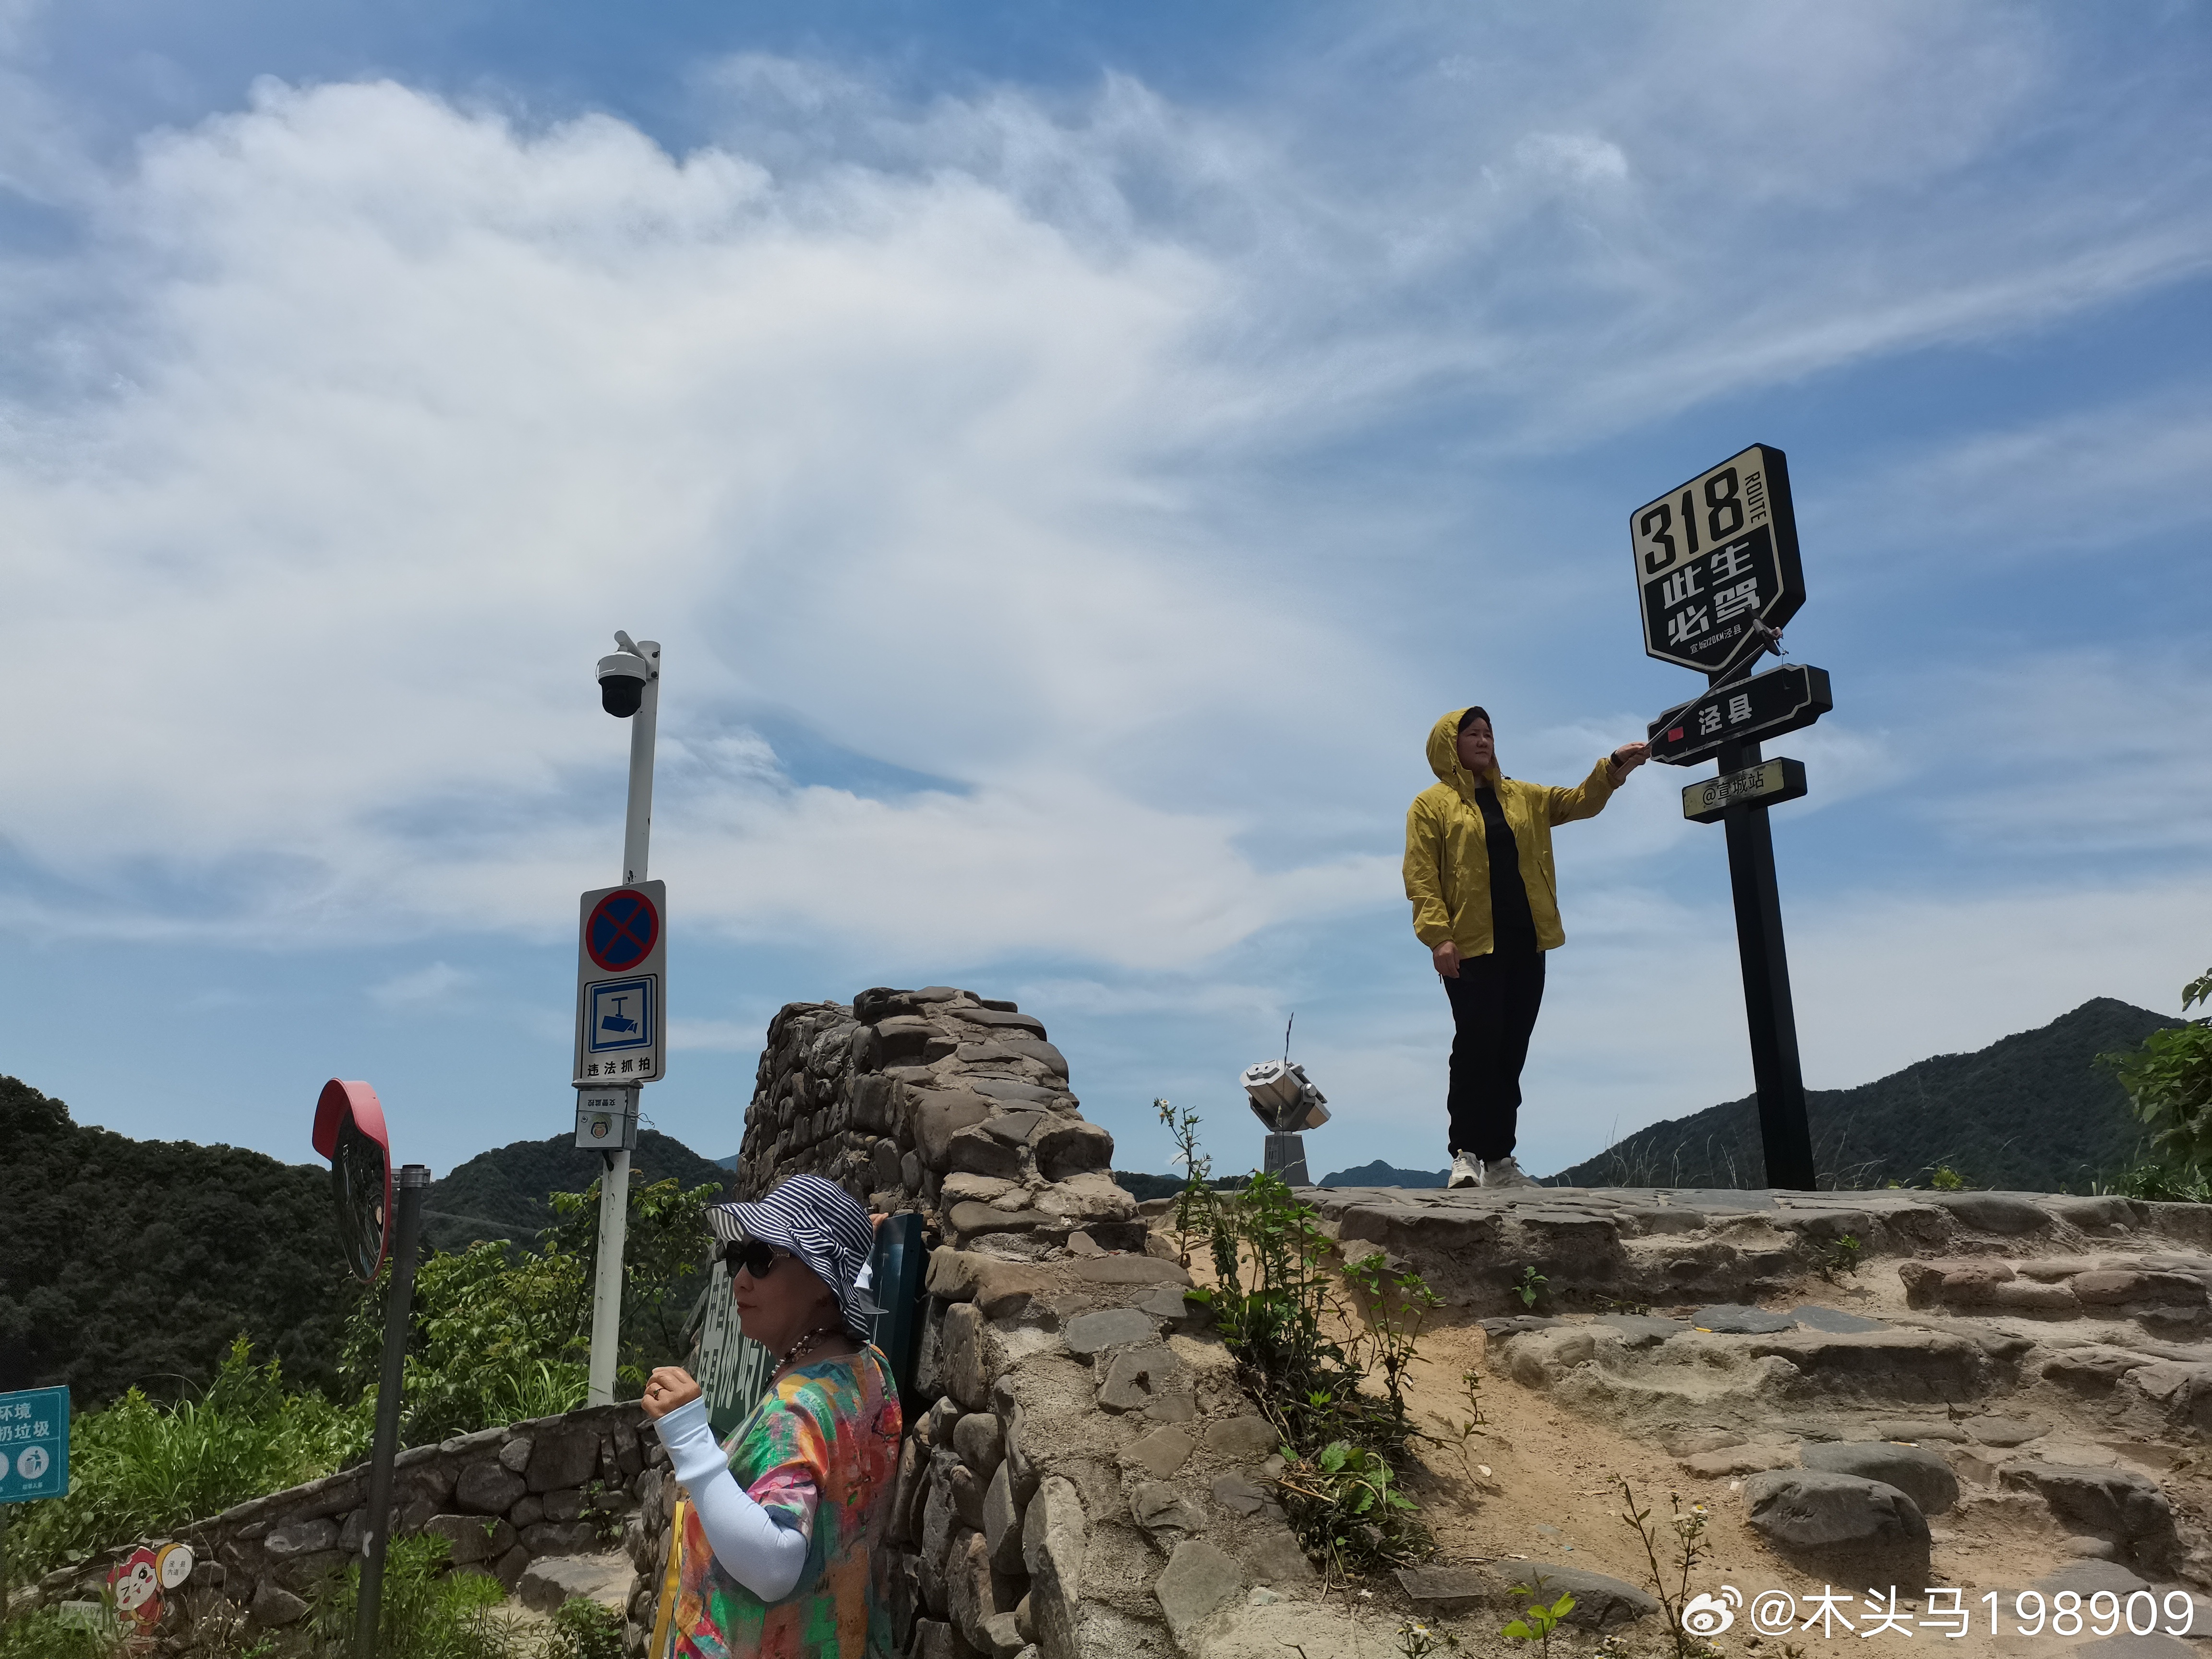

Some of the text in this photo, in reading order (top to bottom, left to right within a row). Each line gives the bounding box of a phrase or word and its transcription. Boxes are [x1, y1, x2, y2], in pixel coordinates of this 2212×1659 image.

[1641, 467, 1744, 575] 318
[1745, 471, 1767, 524] ROUTE
[1662, 541, 1754, 610] 此生
[1668, 577, 1760, 647] 必驾
[1698, 693, 1752, 735] 泾县
[1703, 771, 1764, 805] @宣城站
[587, 1057, 650, 1077] 违法抓拍
